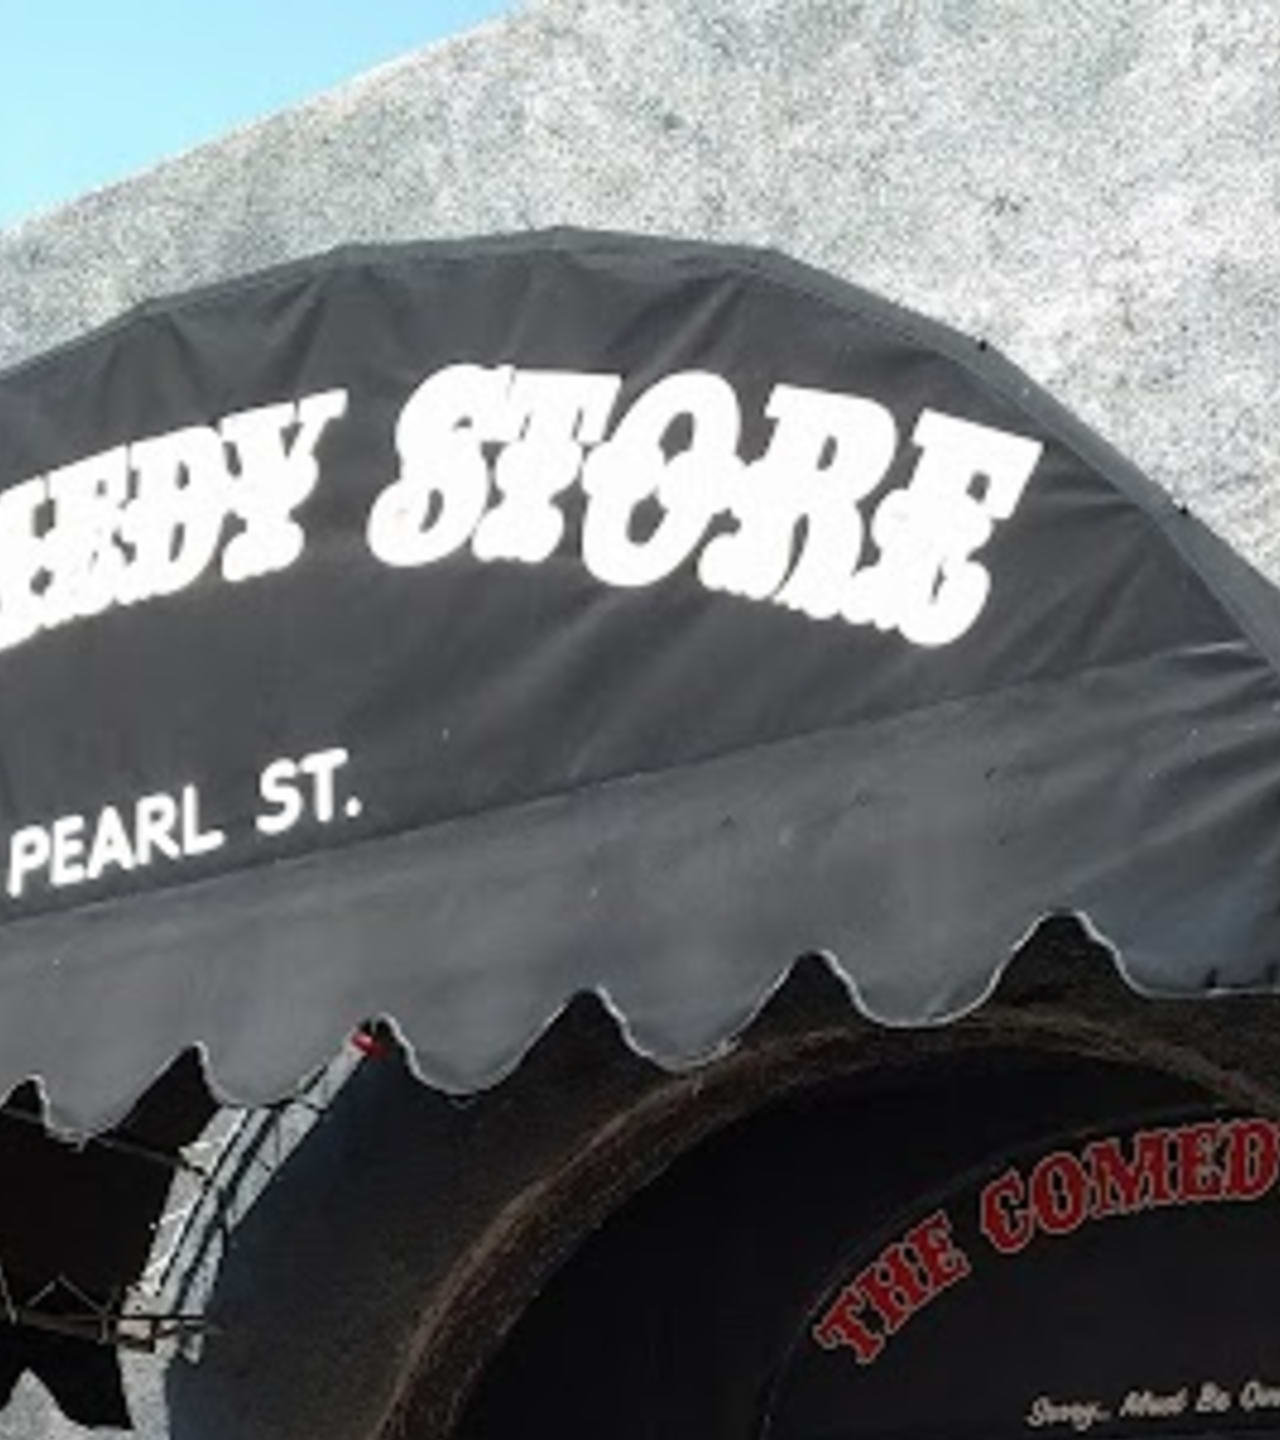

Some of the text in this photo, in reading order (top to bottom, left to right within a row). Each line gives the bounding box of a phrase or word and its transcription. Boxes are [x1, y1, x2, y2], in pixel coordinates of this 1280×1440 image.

[367, 363, 1044, 646] STORE
[7, 784, 225, 897] PEARL
[256, 748, 362, 833] ST.
[815, 1208, 972, 1364] THE
[1195, 1381, 1231, 1412] Be
